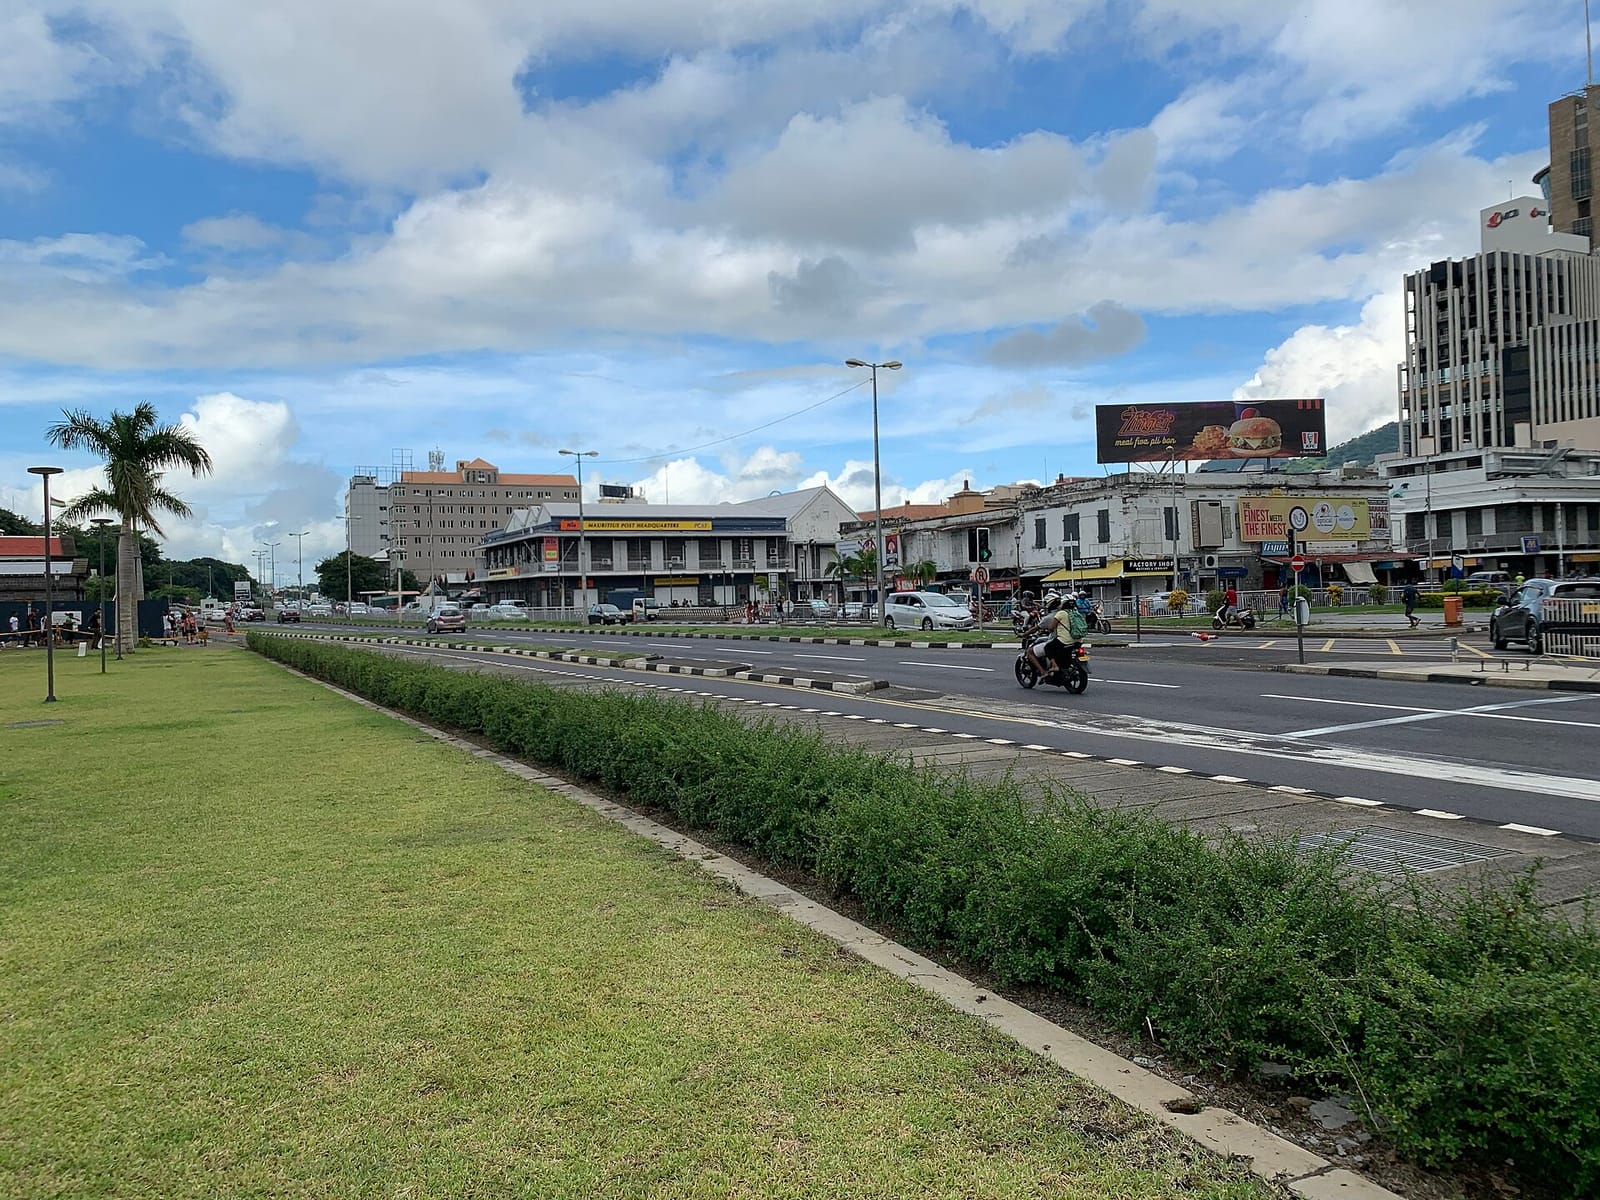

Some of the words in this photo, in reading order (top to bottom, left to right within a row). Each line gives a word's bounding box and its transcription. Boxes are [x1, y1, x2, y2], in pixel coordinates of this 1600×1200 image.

[1243, 509, 1270, 522] FINEST
[1245, 523, 1260, 536] THE
[1261, 523, 1287, 536] FINEST
